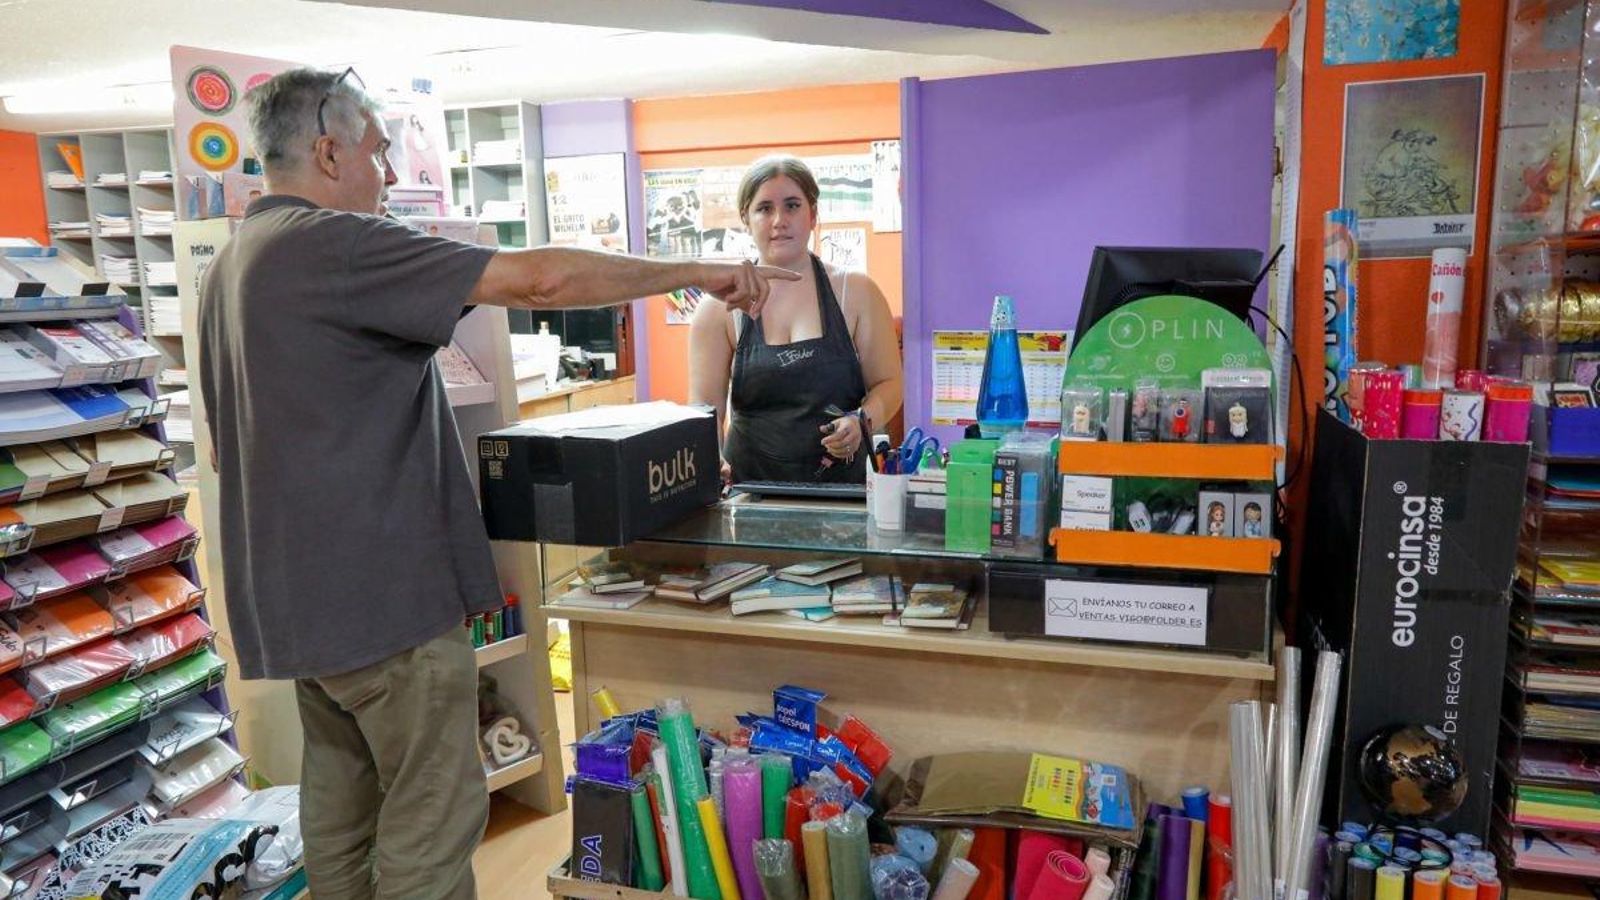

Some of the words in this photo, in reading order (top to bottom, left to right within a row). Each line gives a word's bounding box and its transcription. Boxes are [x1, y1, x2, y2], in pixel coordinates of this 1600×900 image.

[1432, 263, 1462, 276] Cañón
[648, 447, 696, 494] bulk
[998, 458, 1016, 466] BEST
[1003, 470, 1015, 506] POWER
[1077, 489, 1106, 498] Speaker
[1003, 509, 1013, 535] BANK
[1428, 496, 1444, 530] 1984
[1424, 534, 1441, 575] desde
[1150, 602, 1186, 611] CORREO
[1445, 635, 1464, 705] REGALO
[1443, 710, 1458, 733] DE
[581, 834, 602, 882] DA
